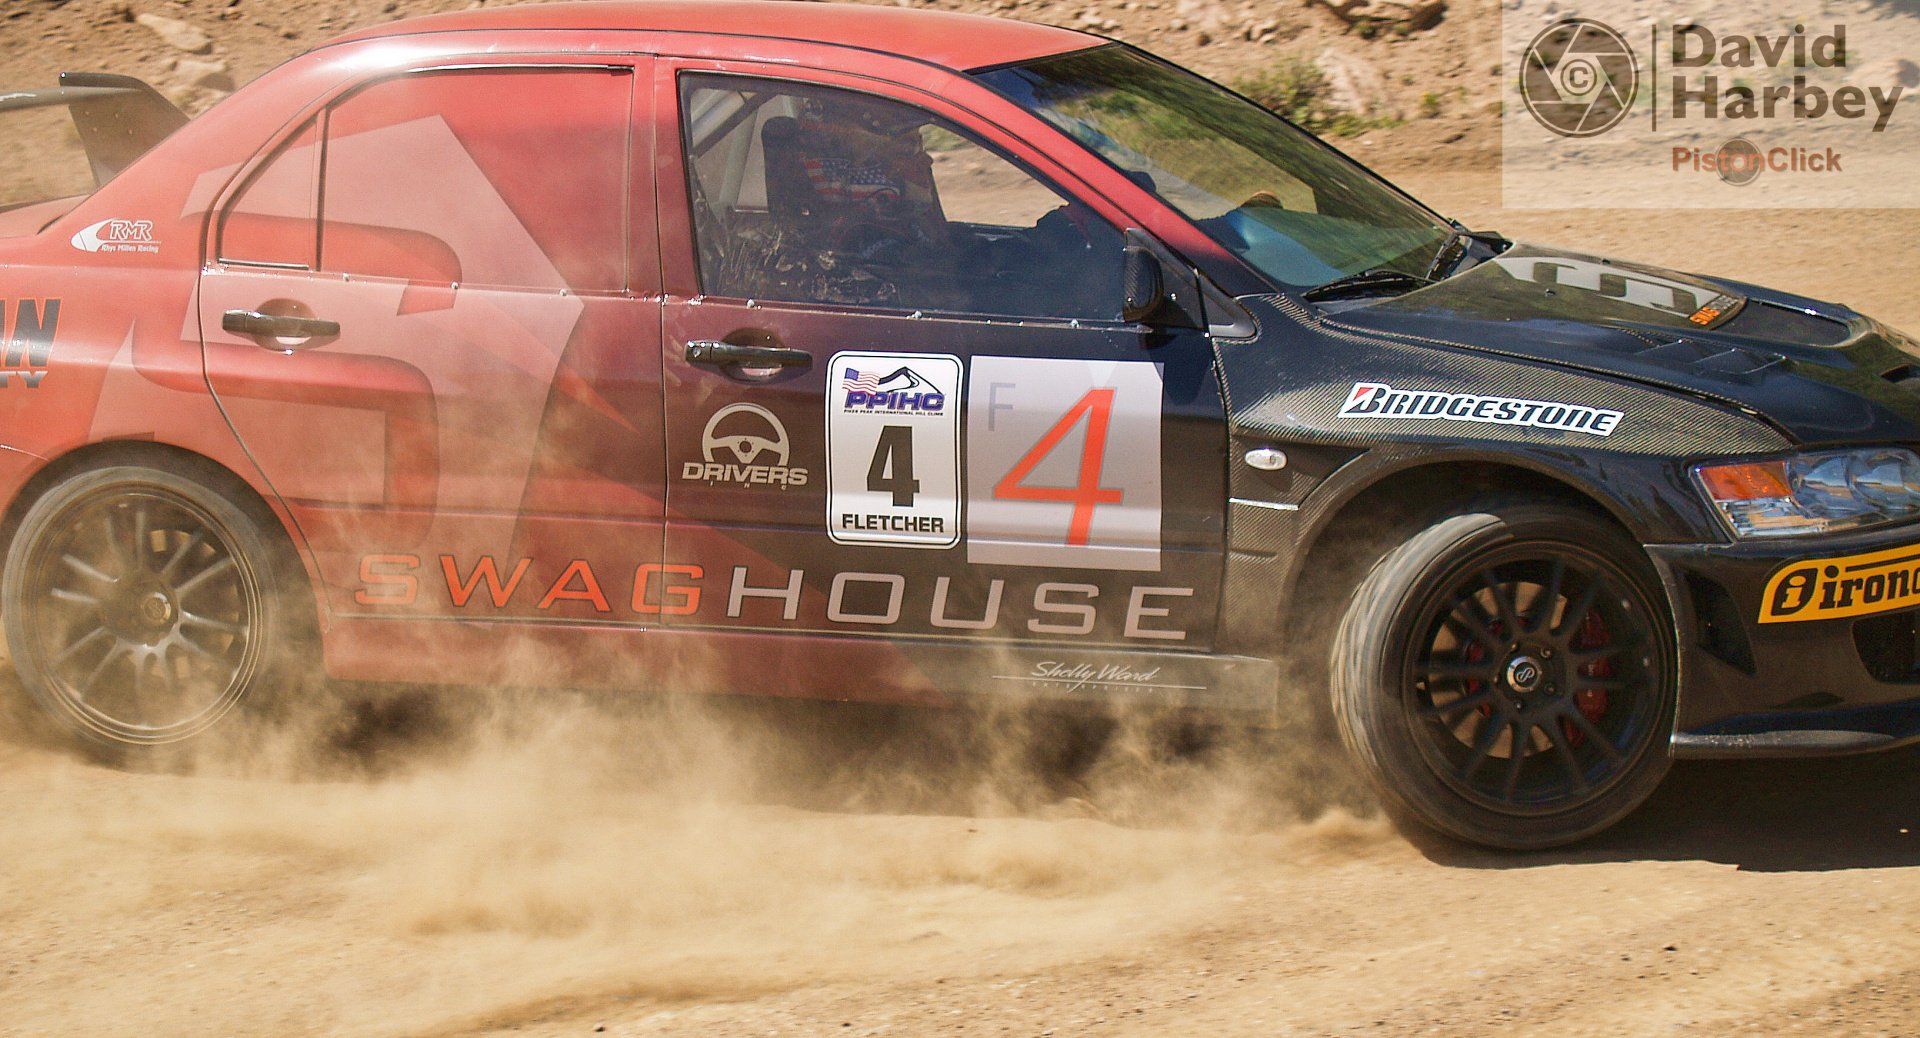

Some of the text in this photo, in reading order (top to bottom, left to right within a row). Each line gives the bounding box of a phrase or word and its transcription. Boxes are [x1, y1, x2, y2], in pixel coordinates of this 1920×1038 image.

[110, 220, 153, 241] RMR
[844, 390, 945, 411] PPIHC
[988, 382, 1016, 432] F
[1345, 386, 1616, 432] BRIDGESTONE
[682, 462, 808, 486] DRIVERS
[866, 425, 920, 508] 4
[992, 387, 1124, 546] 4
[842, 513, 944, 533] FLETCHER
